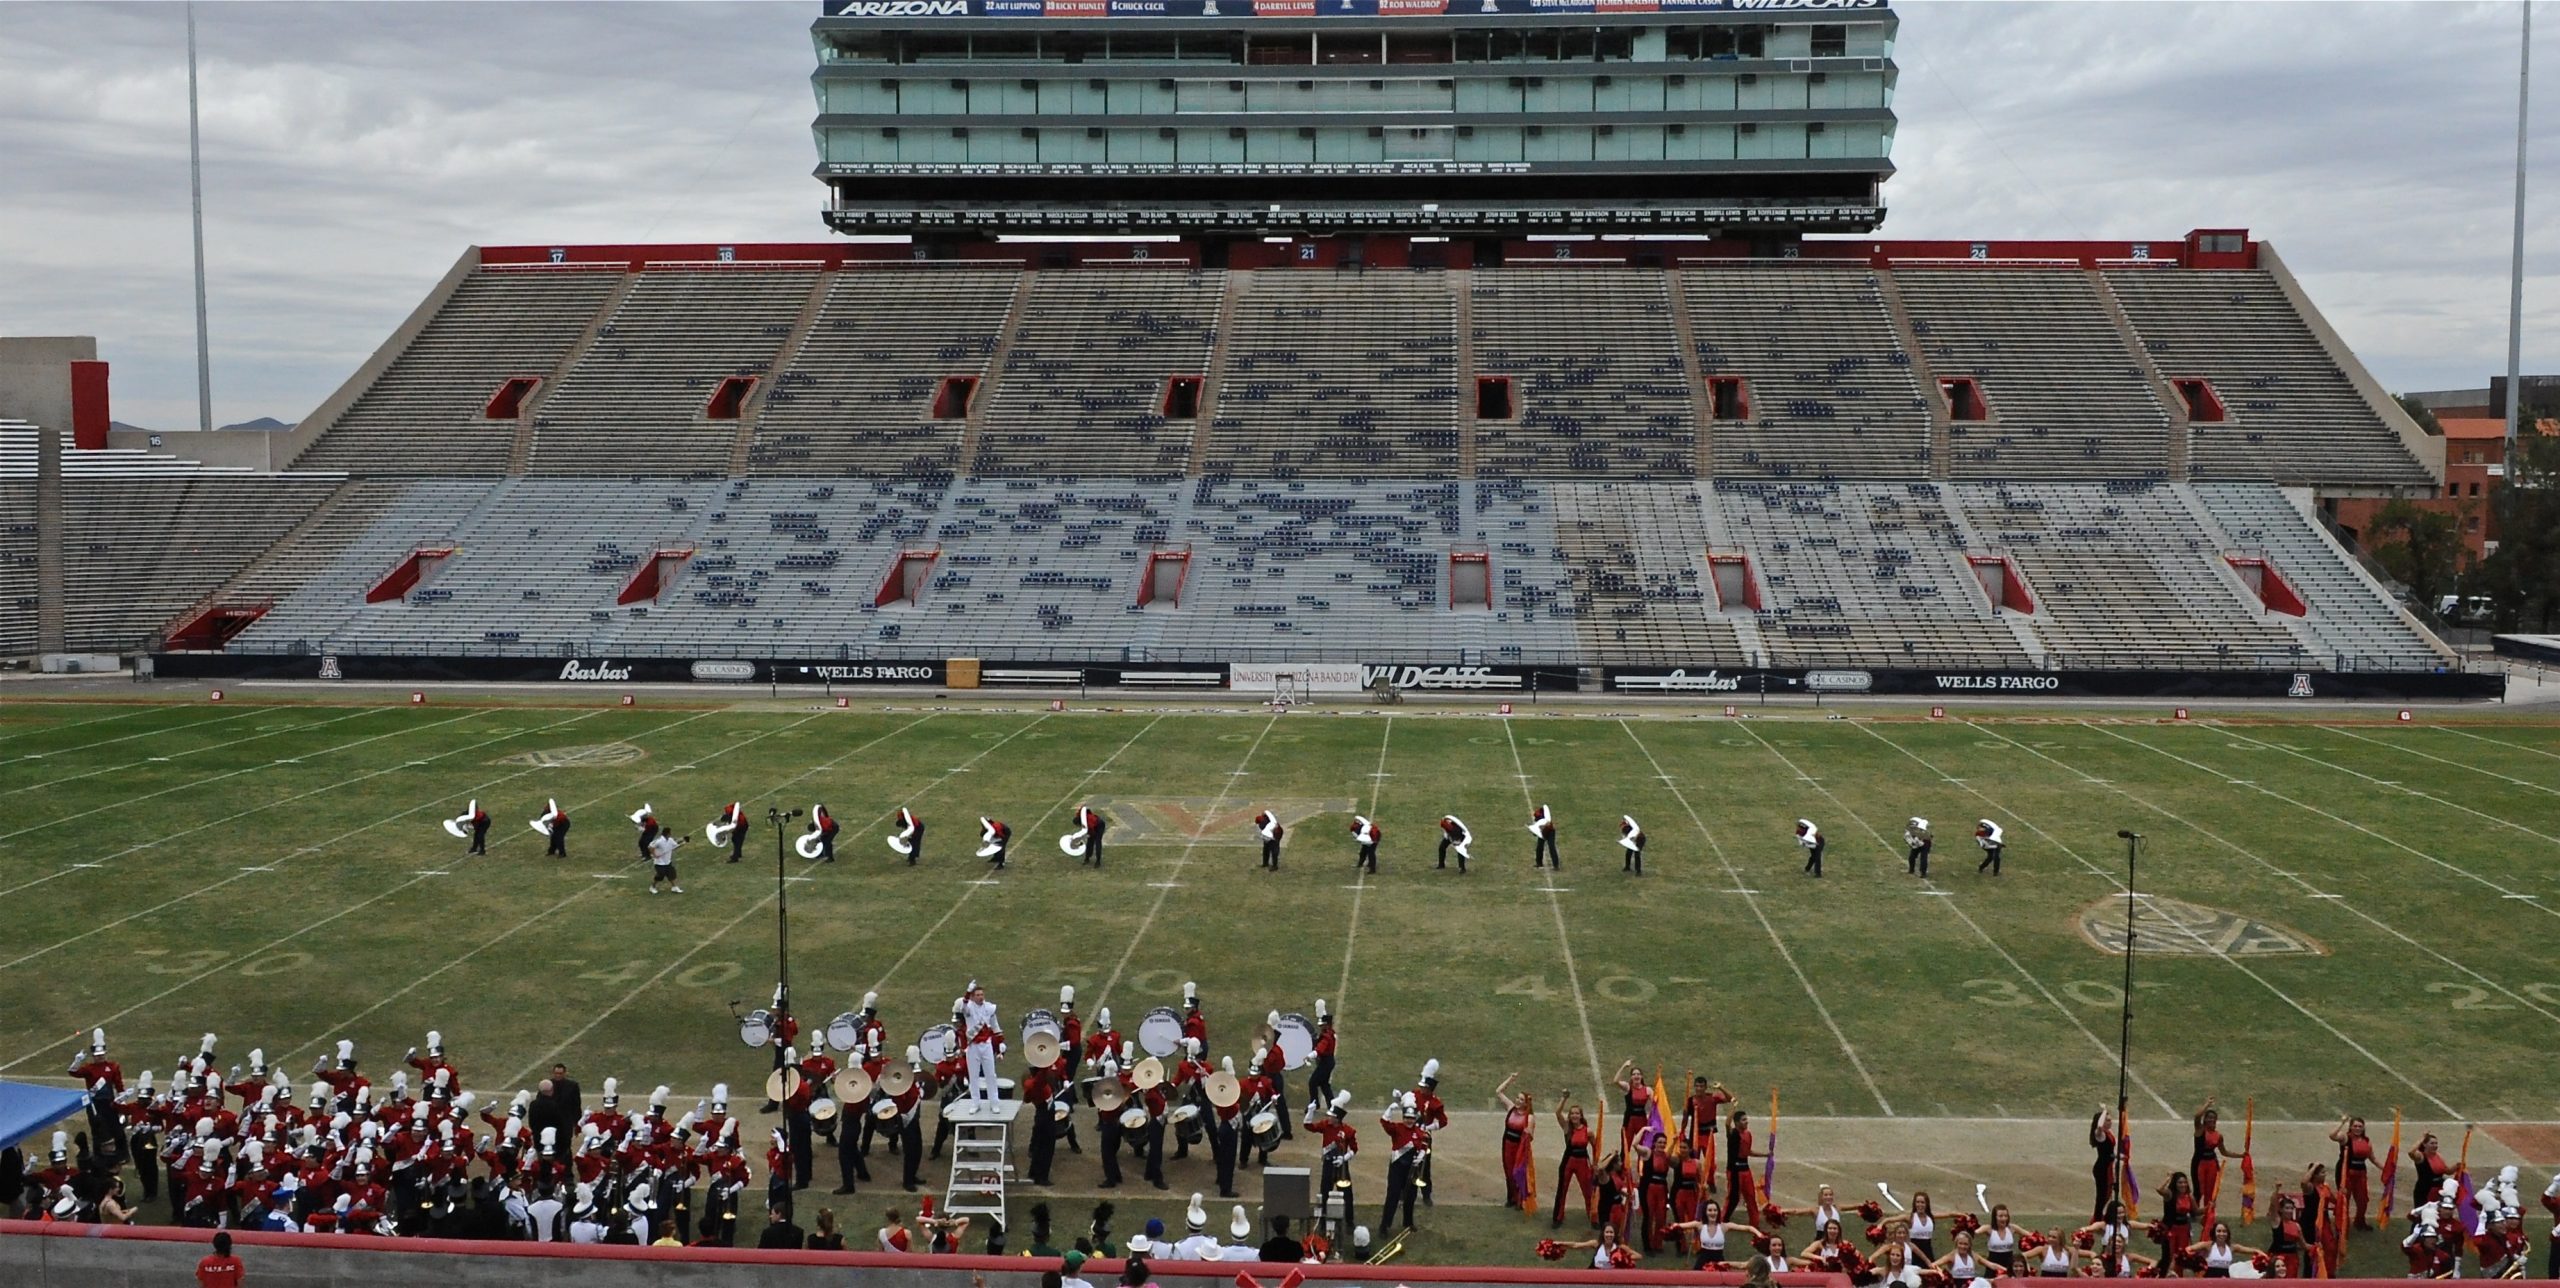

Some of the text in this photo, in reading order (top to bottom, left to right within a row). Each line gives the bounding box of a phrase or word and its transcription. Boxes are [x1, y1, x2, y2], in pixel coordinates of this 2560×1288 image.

[838, 0, 968, 15] ARIZONA
[985, 1, 1041, 10] 22 ART LUPPINO
[1055, 2, 1077, 10] RICKY
[1078, 2, 1106, 10] HUNLEY
[1117, 2, 1144, 10] CHUCK
[1144, 2, 1165, 10] CECIL
[1260, 2, 1292, 10] DARRYLL
[1293, 2, 1315, 10] LEWIS
[1389, 0, 1403, 8] ROB
[1405, 0, 1441, 8] WALDROP
[551, 253, 563, 263] 17
[719, 251, 733, 262] 18
[914, 250, 926, 260] 19
[1133, 249, 1148, 259] 20
[1301, 248, 1315, 259] 21
[1556, 248, 1570, 259] 22
[1784, 248, 1798, 258] 23
[1971, 248, 1986, 259] 24
[2132, 249, 2148, 260] 25
[150, 436, 161, 446] 16
[559, 660, 633, 681] Bashas'
[815, 666, 933, 679] WELLS FARGO
[1233, 671, 1273, 682] UNIVERSITY
[1320, 671, 1342, 683] BAND
[1343, 672, 1359, 683] DAY
[1935, 676, 2059, 689] WELLS FARGO
